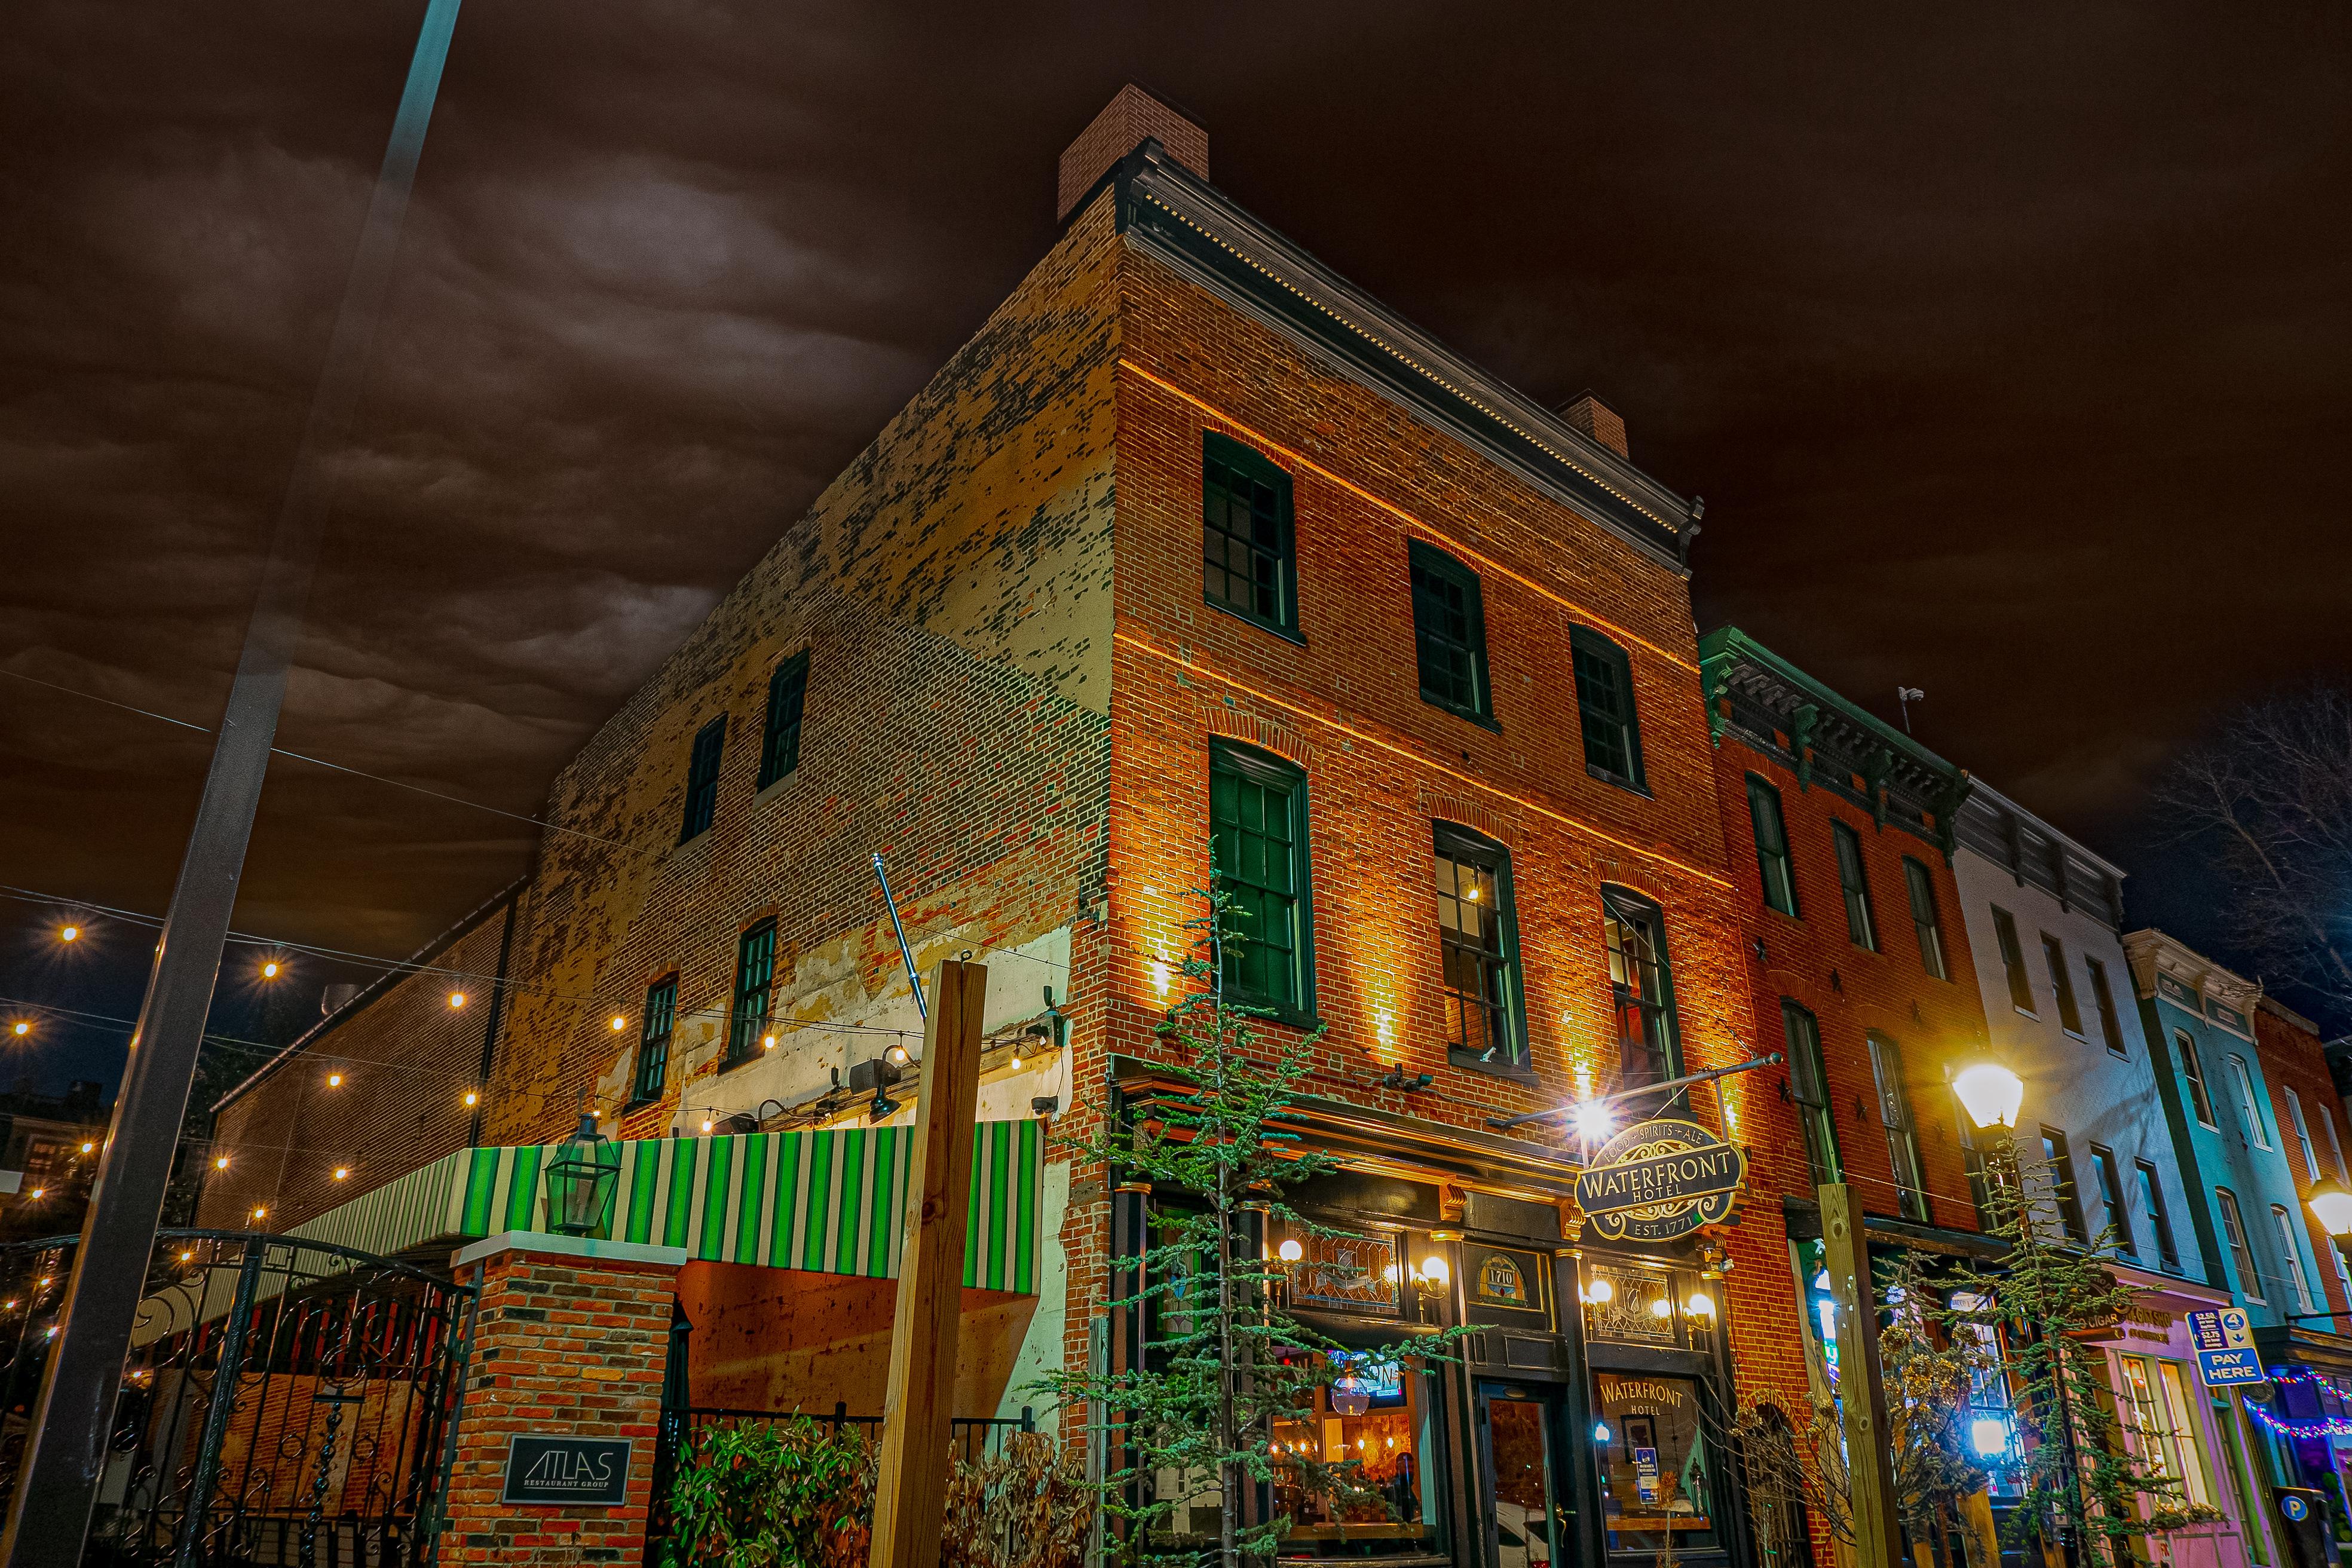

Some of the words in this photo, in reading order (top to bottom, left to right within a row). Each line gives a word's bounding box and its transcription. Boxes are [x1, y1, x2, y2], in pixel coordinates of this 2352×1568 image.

[1603, 1137, 1630, 1163] FOOD
[1638, 1125, 1673, 1140] SPIRITS
[1683, 1128, 1703, 1144] ALE
[1582, 1151, 1730, 1199] WATERFRONT
[1632, 1184, 1682, 1203] HOTEL
[1634, 1224, 1661, 1236] EST.
[1665, 1215, 1692, 1234] 1771
[1490, 1269, 1512, 1284] 1710
[2088, 1313, 2119, 1328] CIGAR
[2227, 1314, 2241, 1326] 4
[2212, 1353, 2243, 1366] PAY
[2209, 1366, 2256, 1380] HERE
[1600, 1382, 1683, 1408] WATERFRONT
[1631, 1405, 1660, 1416] HOTEL
[525, 1450, 614, 1480] ATLAS
[2289, 1500, 2301, 1517] P
